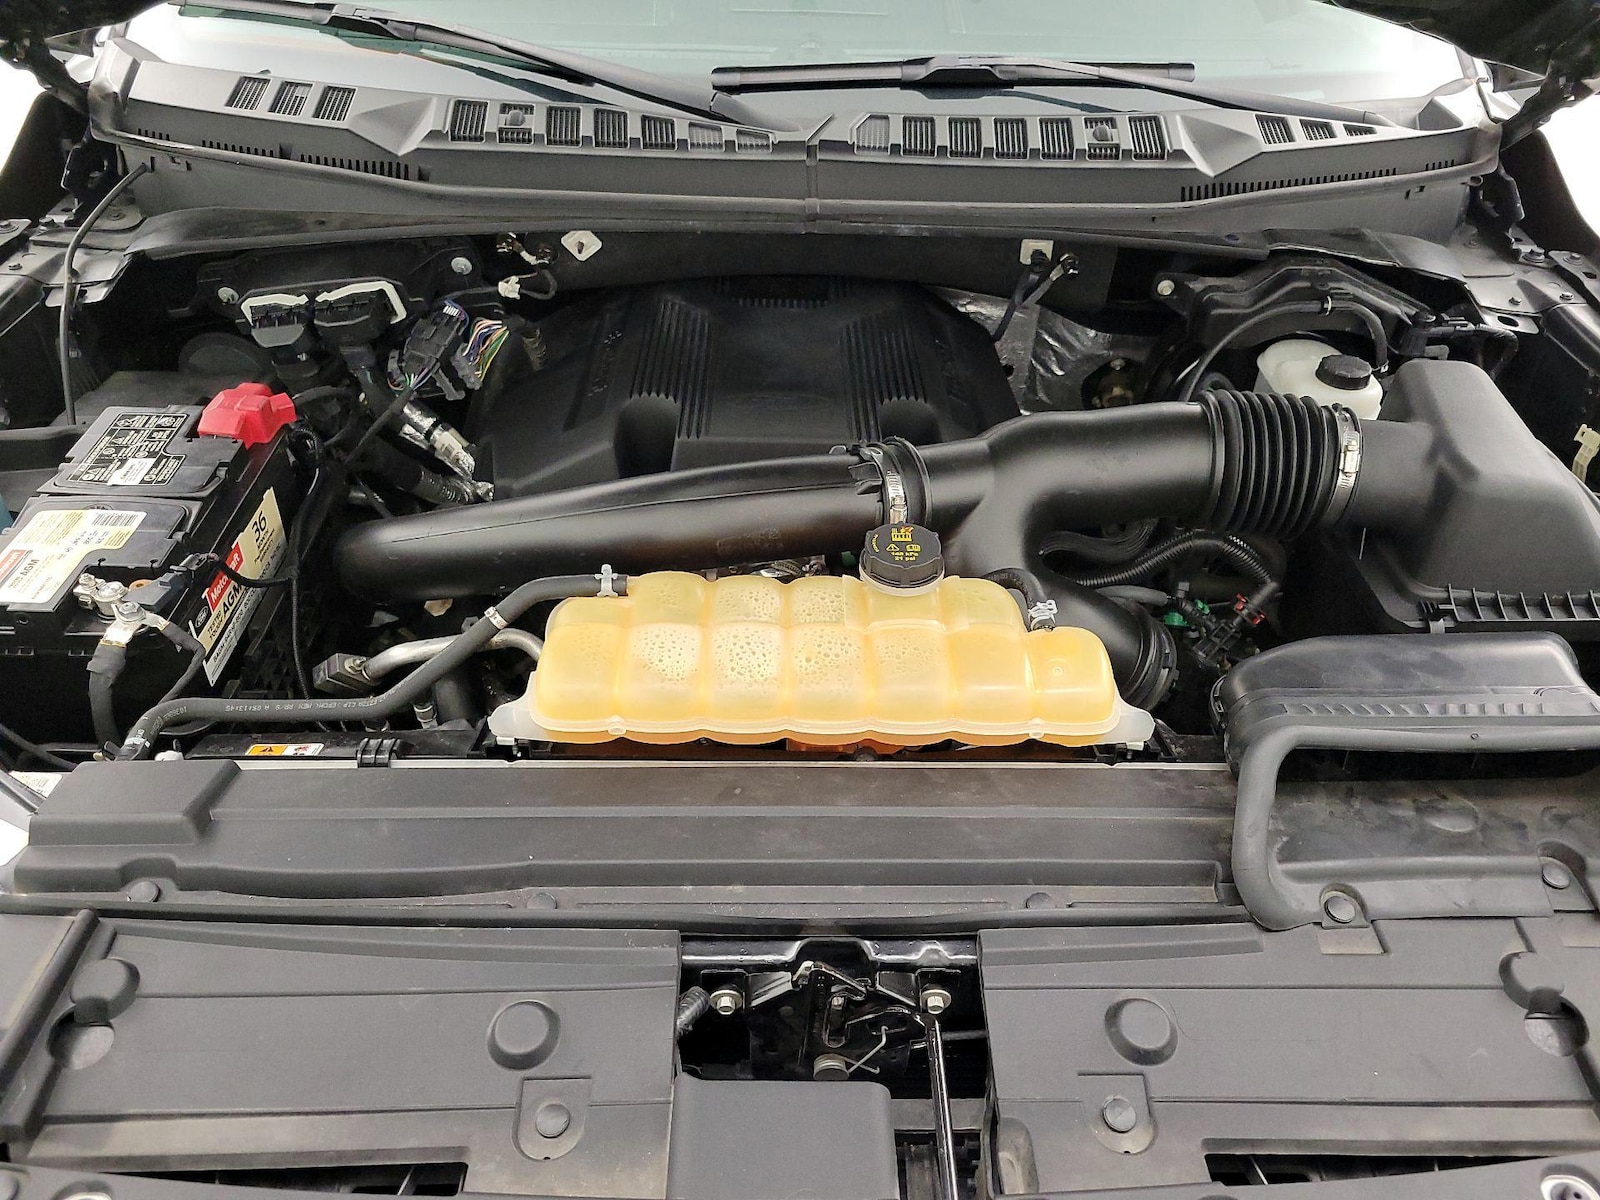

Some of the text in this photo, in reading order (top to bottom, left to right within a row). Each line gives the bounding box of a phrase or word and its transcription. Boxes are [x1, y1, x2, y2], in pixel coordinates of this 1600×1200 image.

[251, 511, 267, 542] 36
[20, 559, 40, 576] AGM
[210, 552, 240, 603] Motoaft
[222, 584, 242, 617] AGM
